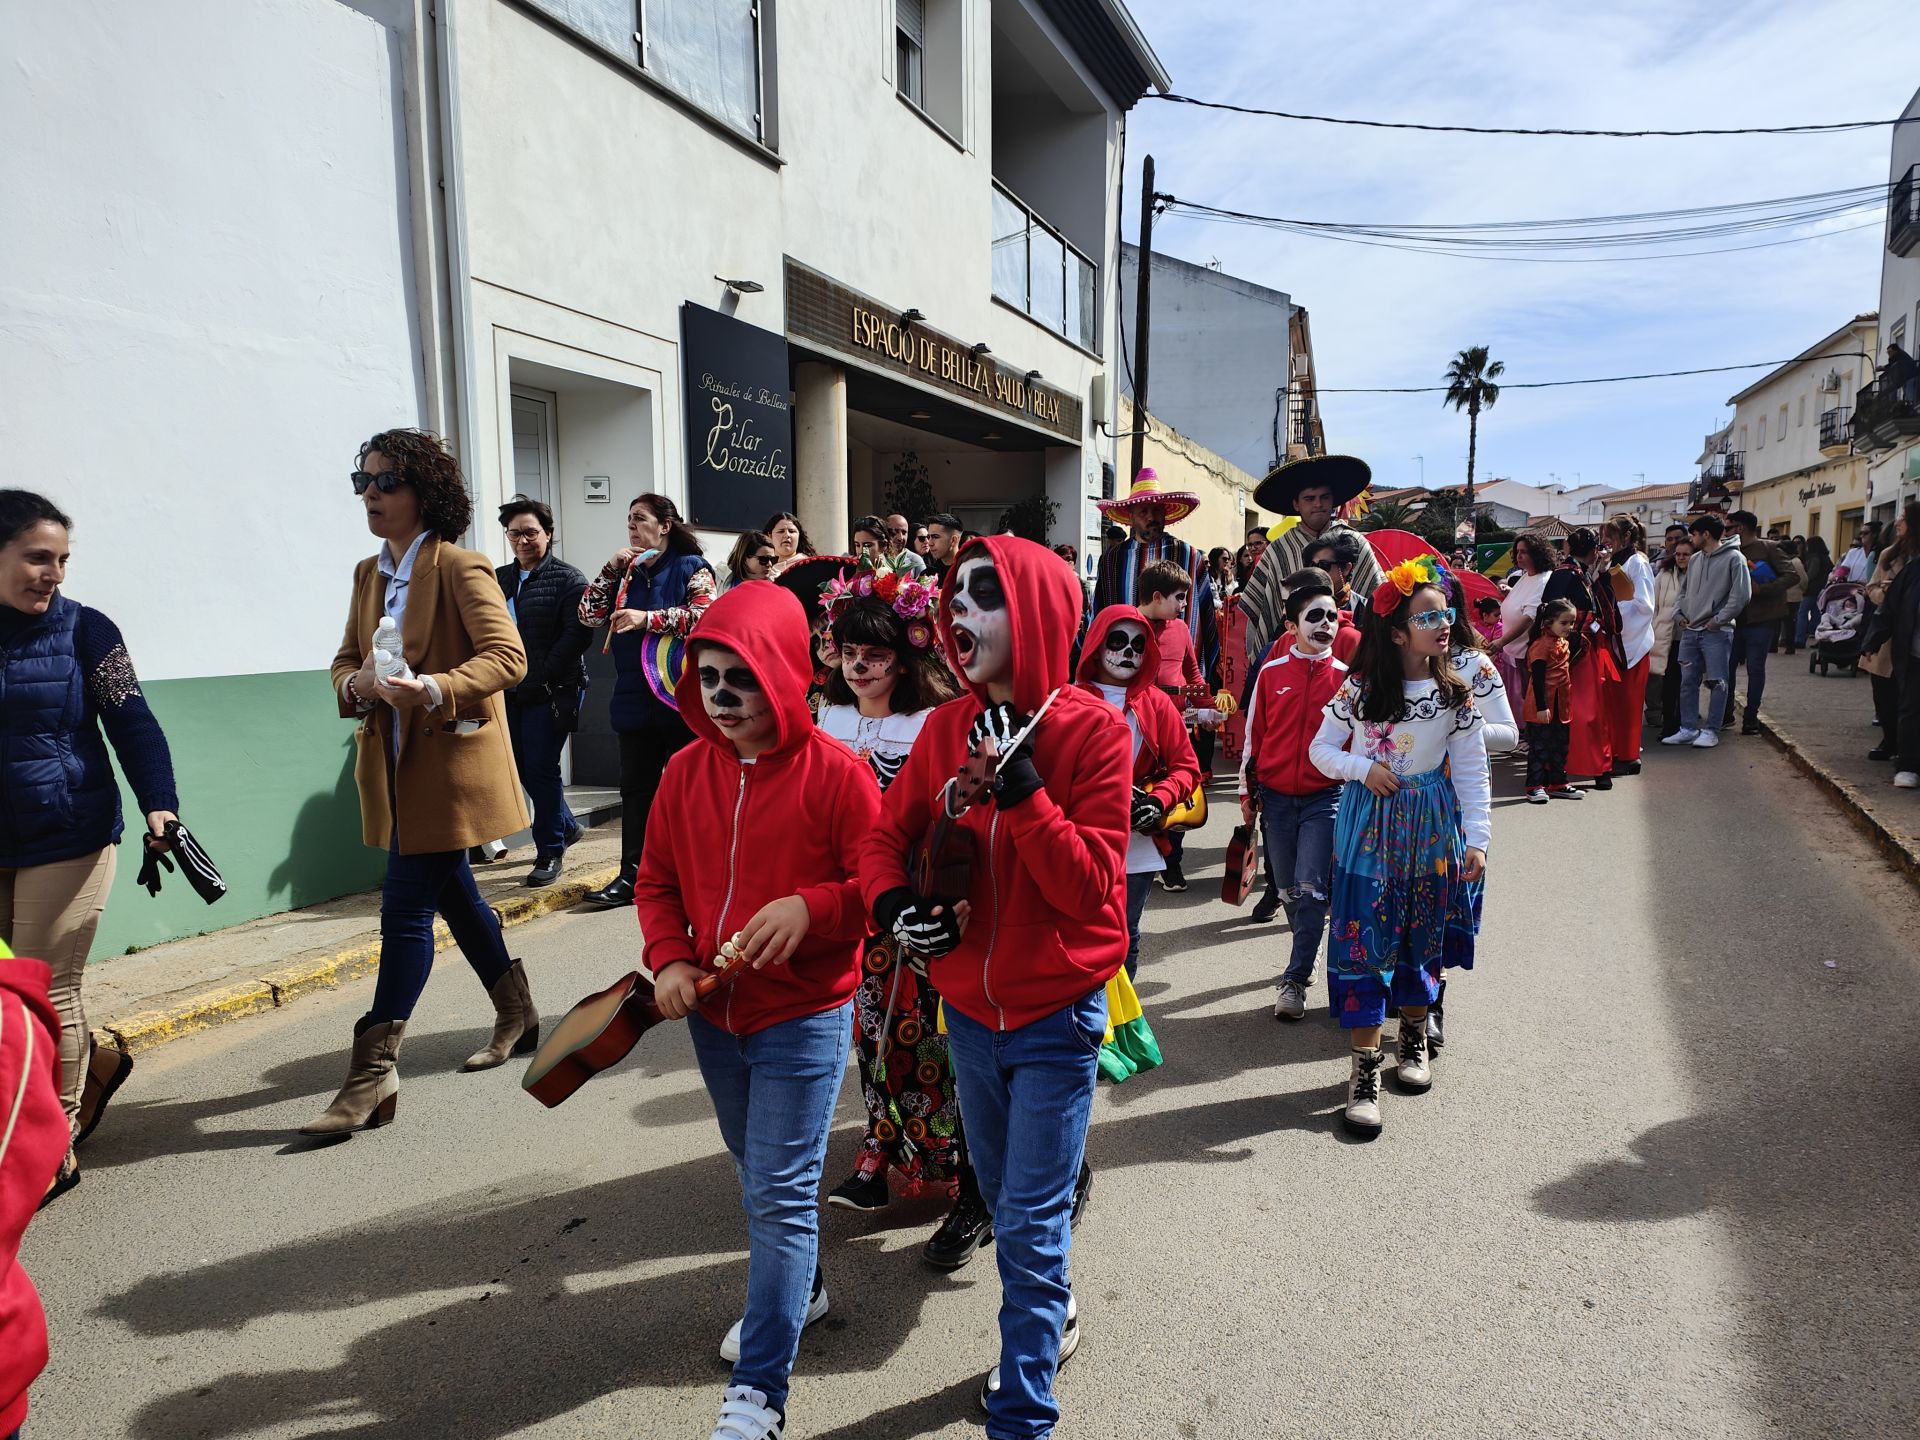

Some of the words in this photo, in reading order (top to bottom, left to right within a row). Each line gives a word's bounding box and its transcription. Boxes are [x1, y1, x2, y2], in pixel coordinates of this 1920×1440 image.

[698, 372, 740, 398] Rituales
[742, 386, 753, 402] de
[755, 388, 787, 411] Belleza
[853, 306, 915, 364] ESPACIO
[920, 337, 936, 374] DE
[941, 346, 992, 399] BELLEZA,
[995, 371, 1025, 409] SALUD
[1026, 386, 1034, 413] Y
[1034, 389, 1060, 424] RELAX
[708, 396, 763, 451] Pilar
[696, 426, 787, 480] González
